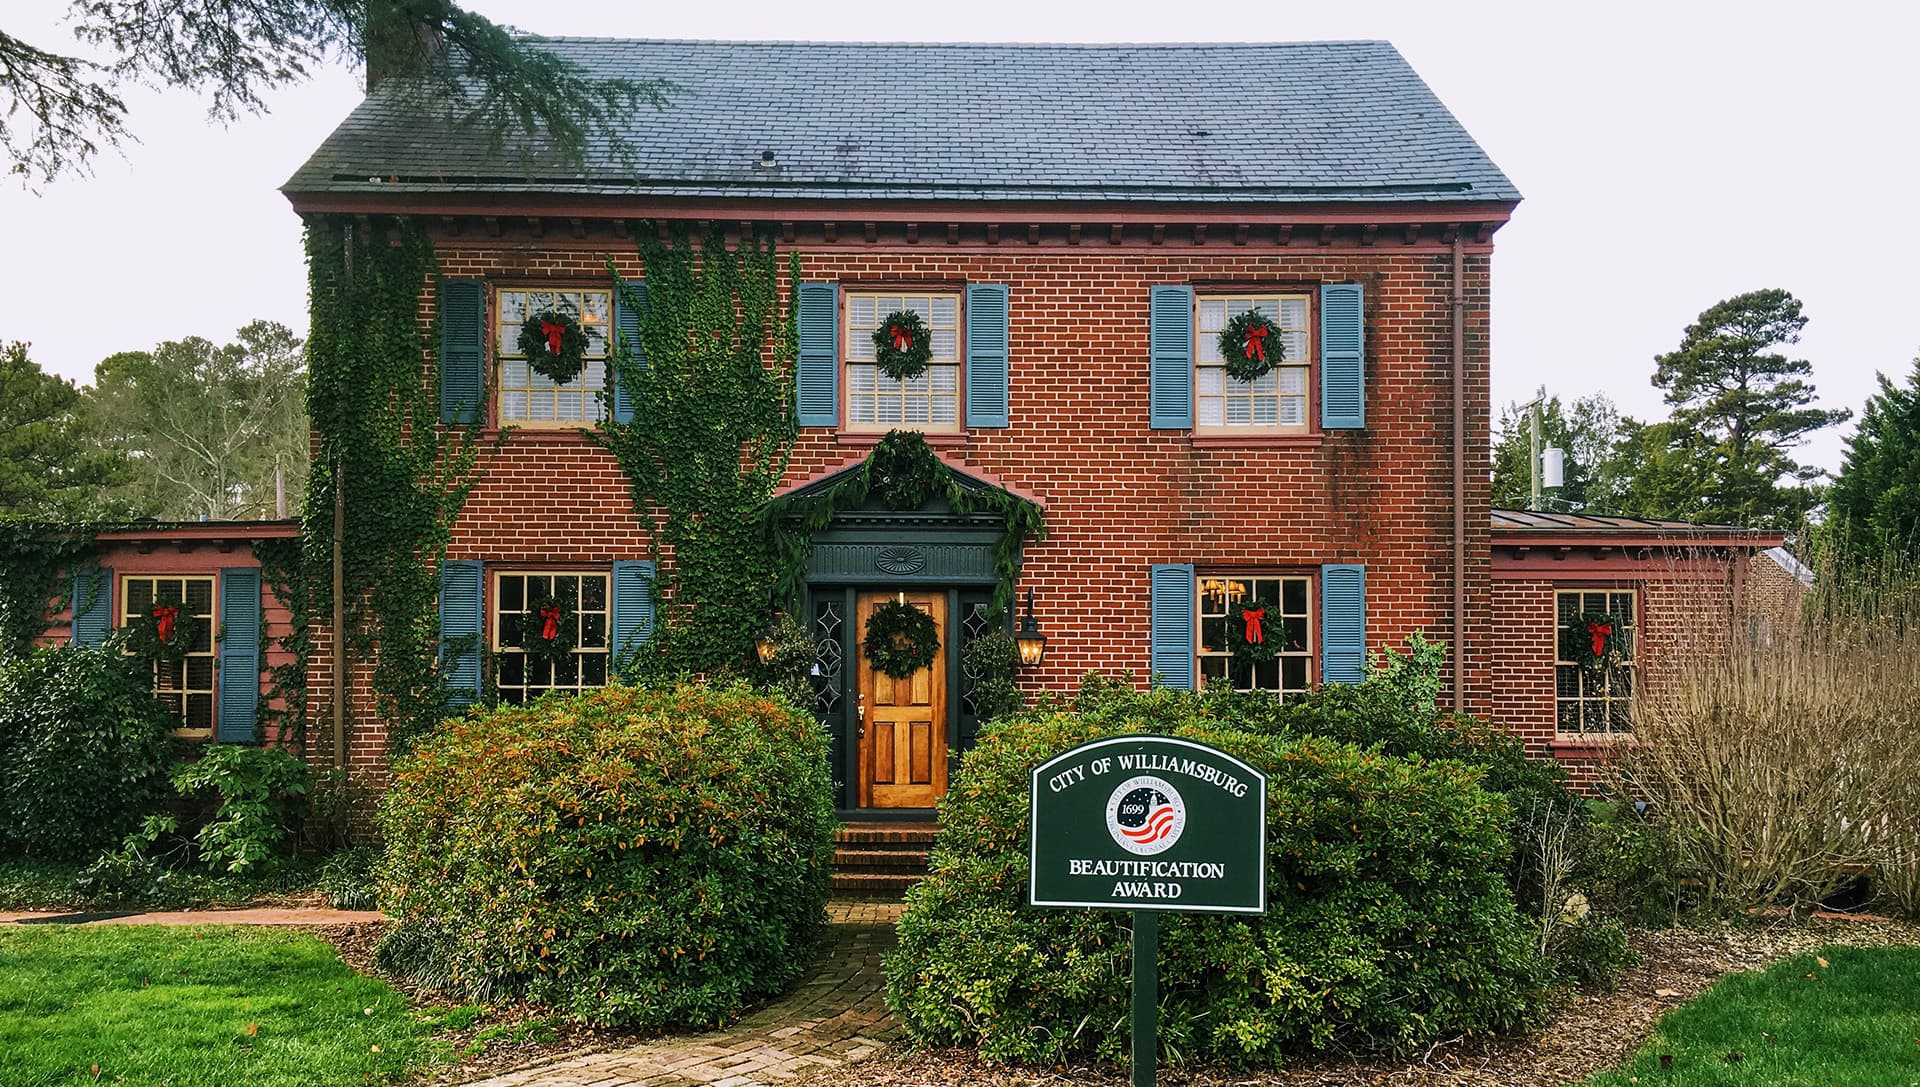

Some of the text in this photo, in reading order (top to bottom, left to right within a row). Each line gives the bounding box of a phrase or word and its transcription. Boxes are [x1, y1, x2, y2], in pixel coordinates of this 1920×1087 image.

[1049, 754, 1248, 798] CITY OF WILLIAMSBURG
[1122, 804, 1144, 814] 1699
[1069, 860, 1225, 878] BEAUTIFICATION
[1111, 882, 1182, 899] AWARD
